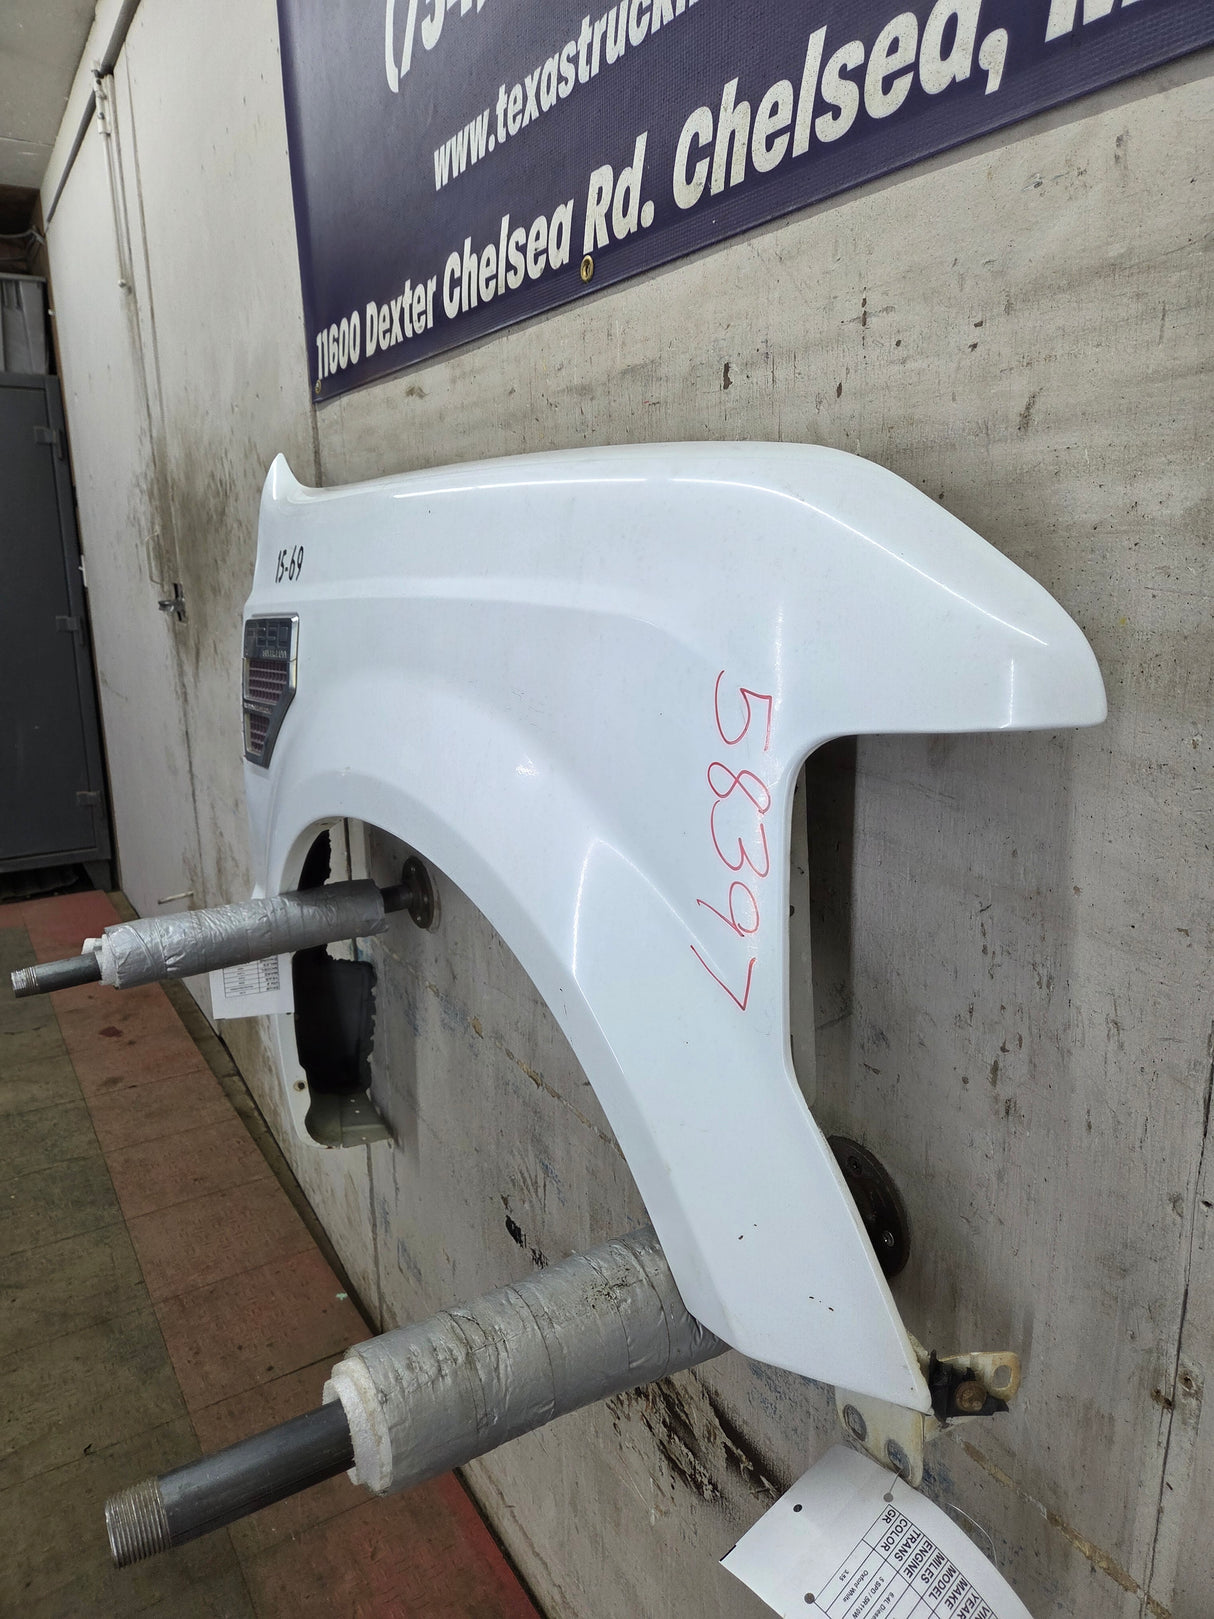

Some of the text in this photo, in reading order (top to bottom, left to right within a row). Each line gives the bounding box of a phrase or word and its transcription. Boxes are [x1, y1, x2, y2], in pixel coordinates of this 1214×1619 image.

[433, 0, 700, 191] www.texastruc
[315, 0, 1009, 379] 11600 Dexter Chelsea Rd. Chelsea,
[275, 544, 304, 584] 15-69
[881, 1509, 897, 1524] GR
[880, 1518, 908, 1552] COLOR
[894, 1529, 922, 1562] TRANS
[903, 1540, 934, 1579] ENGINE
[920, 1552, 945, 1584] MILES
[853, 1569, 869, 1588] Oxford
[928, 1565, 957, 1600] MODEL
[944, 1577, 968, 1610] MAKE
[957, 1593, 979, 1619] YEAR
